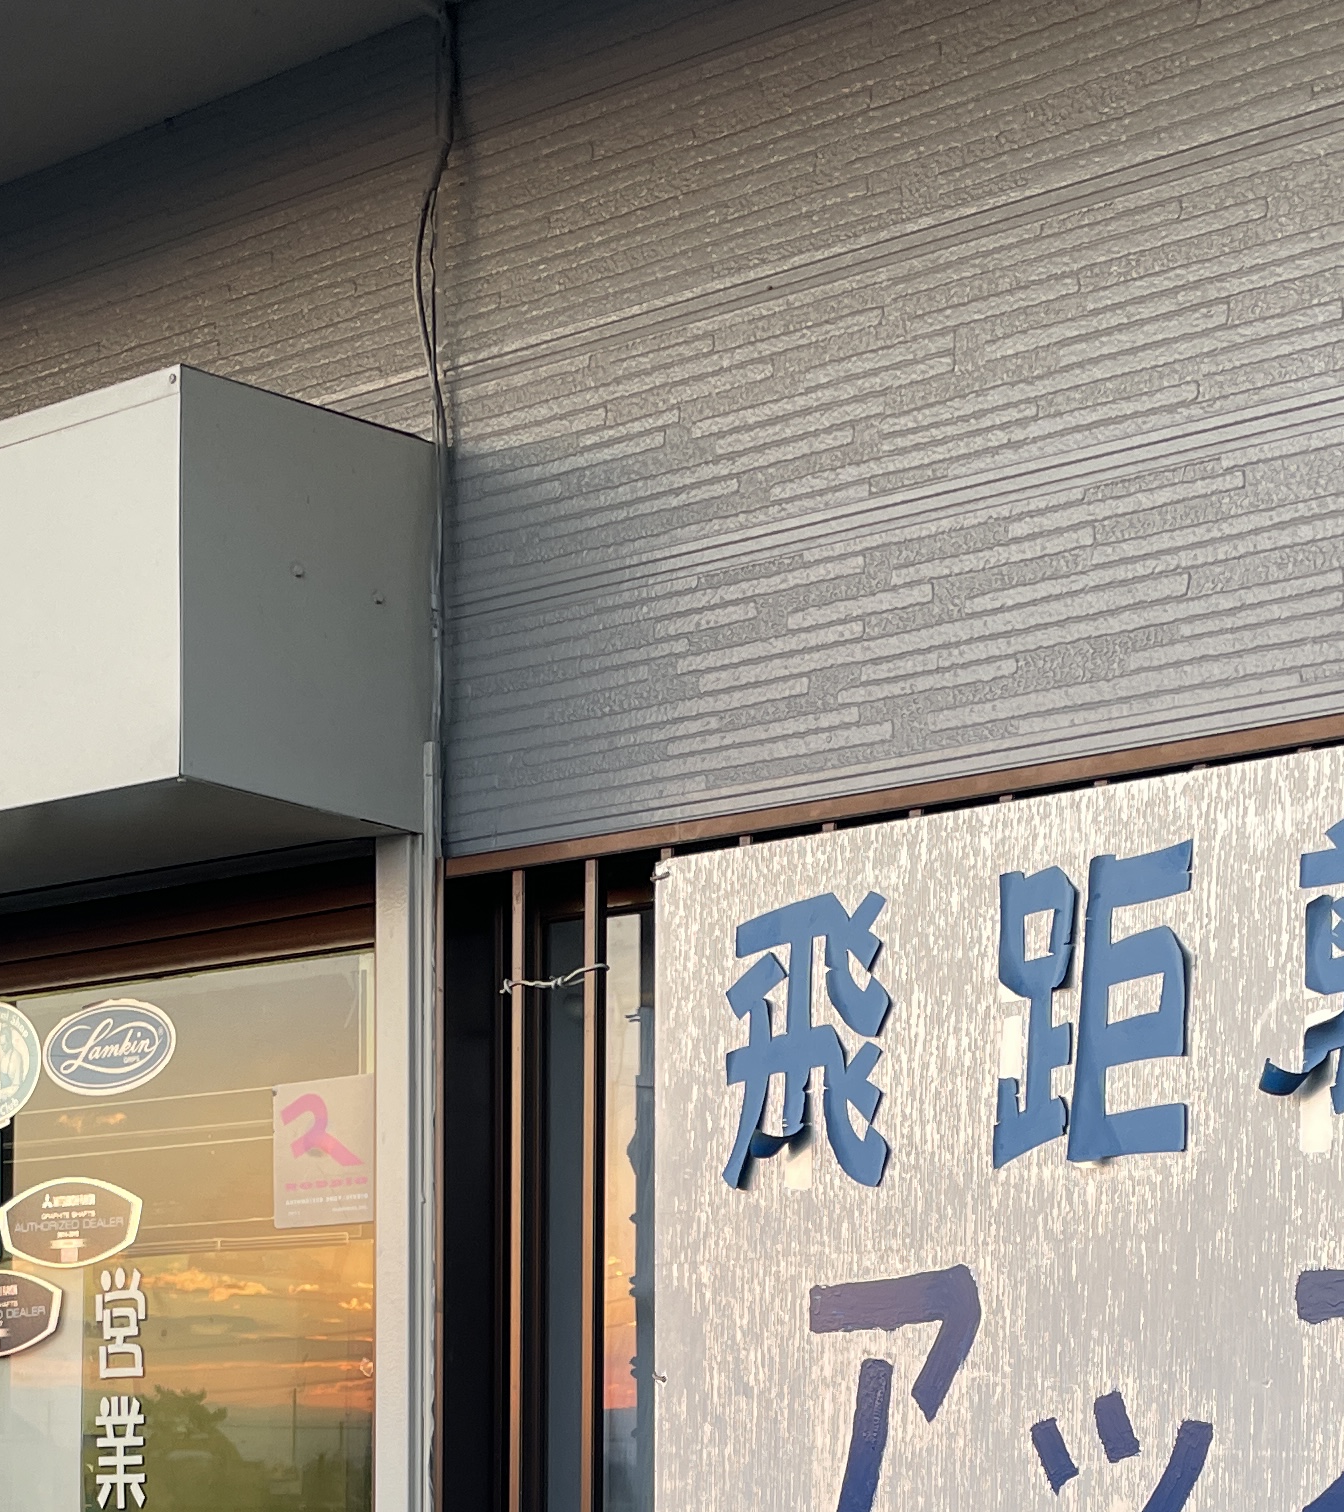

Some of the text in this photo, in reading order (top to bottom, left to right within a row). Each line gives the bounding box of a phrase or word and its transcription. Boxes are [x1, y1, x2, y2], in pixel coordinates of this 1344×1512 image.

[10, 1014, 29, 1038] Shop
[59, 1017, 162, 1075] Lamkin
[0, 1098, 20, 1116] Club
[14, 1216, 124, 1233] AUTHORIZED DEALER
[5, 1305, 46, 1320] DEALER
